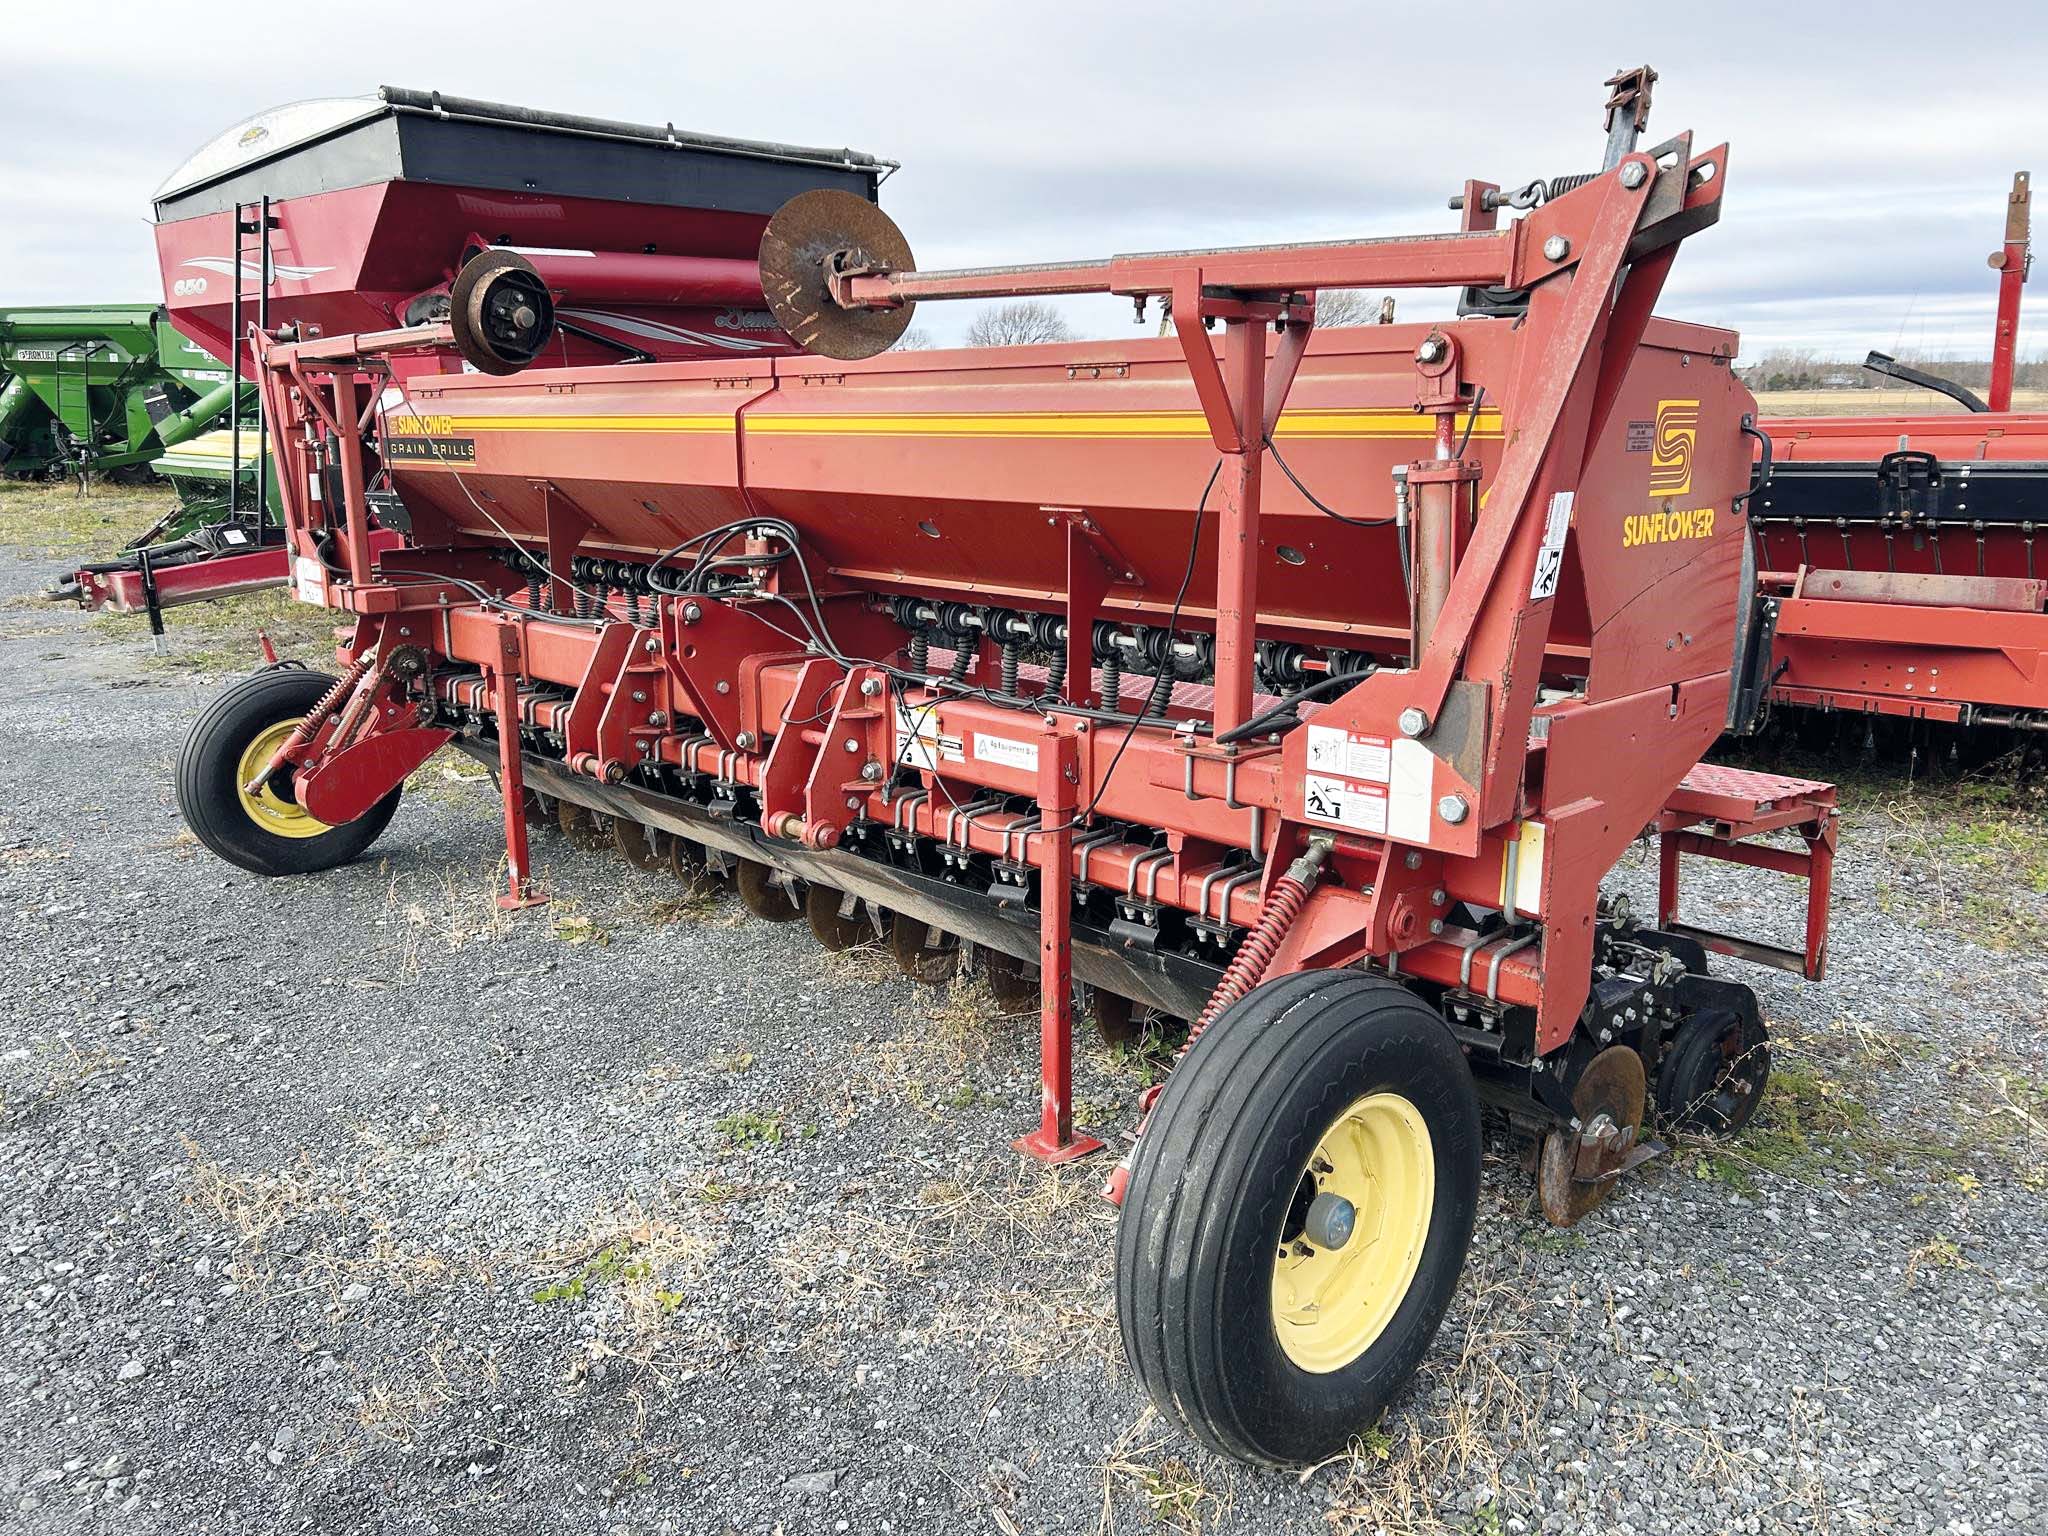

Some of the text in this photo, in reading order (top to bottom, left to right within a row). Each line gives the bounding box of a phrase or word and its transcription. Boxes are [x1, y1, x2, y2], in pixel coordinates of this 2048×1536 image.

[25, 350, 55, 360] FRONTIER
[391, 443, 474, 456] GRAIN DRILLS
[1623, 508, 1715, 548] SUNFLOWER
